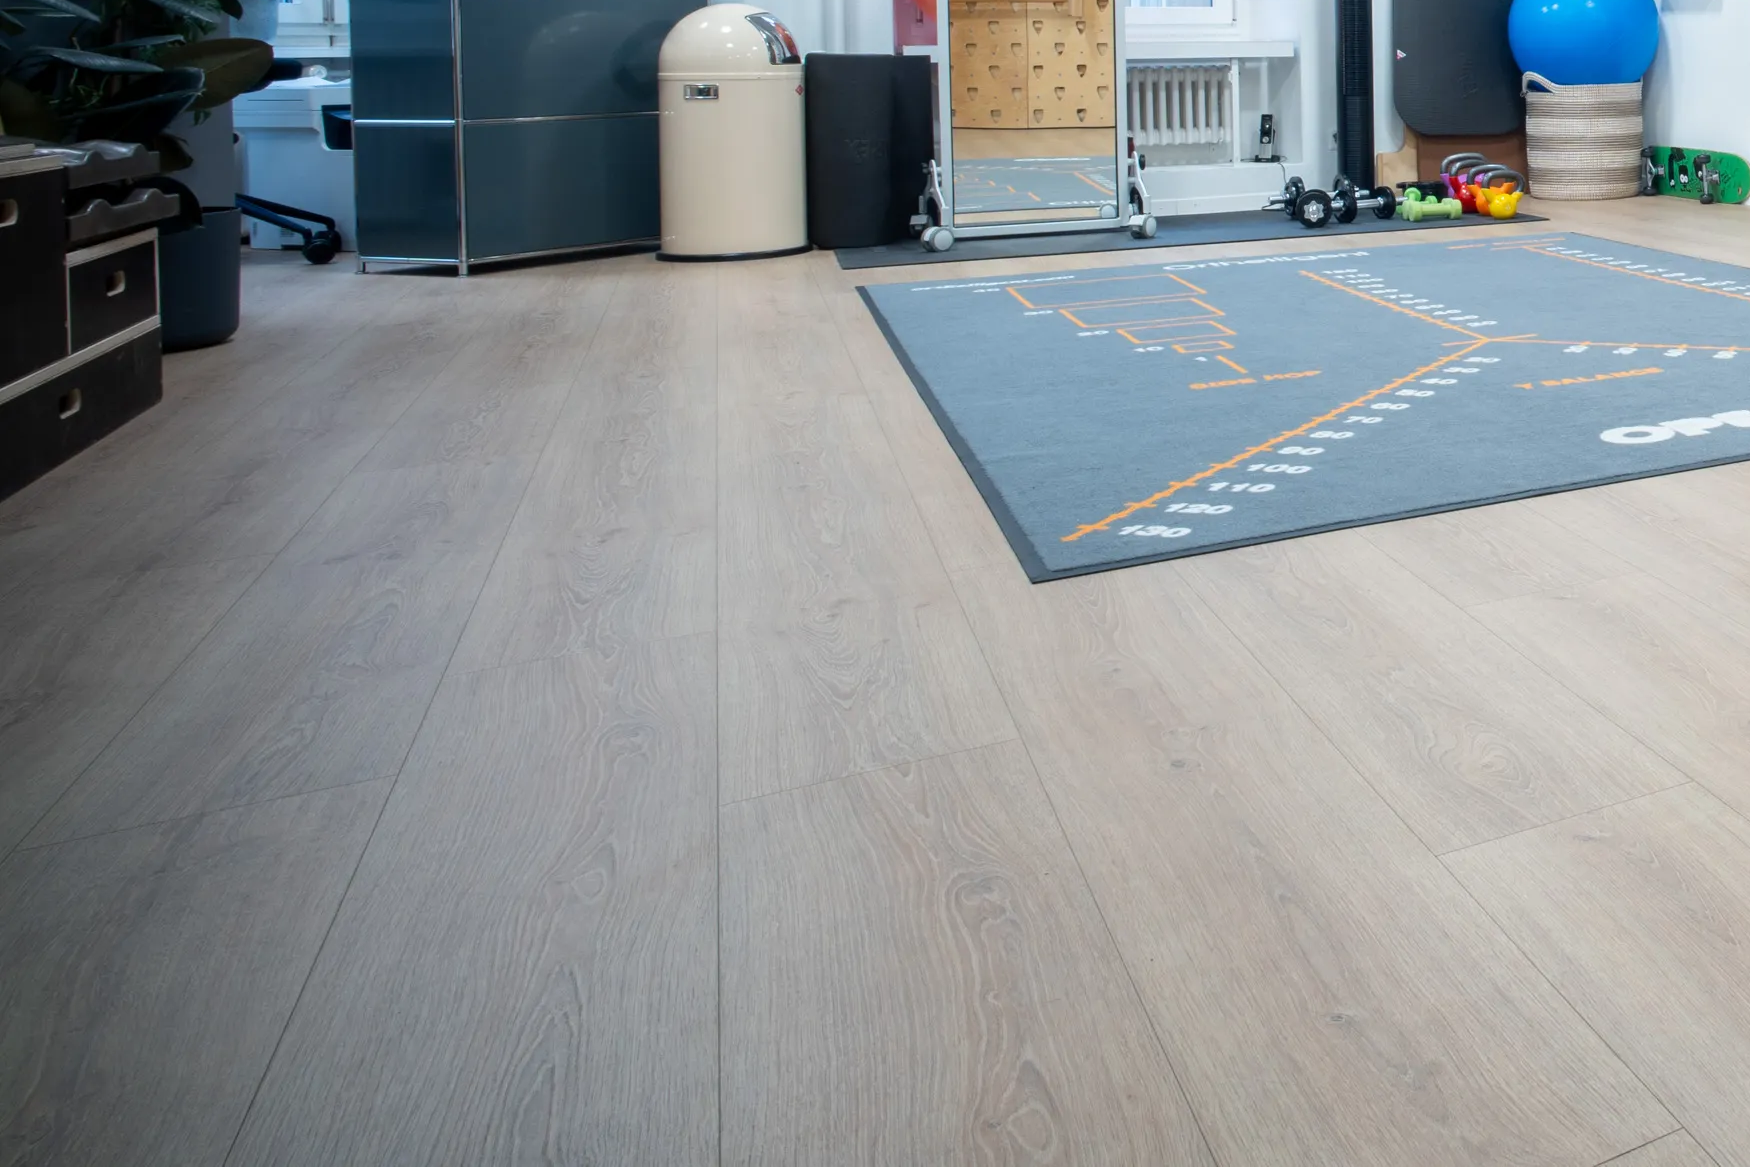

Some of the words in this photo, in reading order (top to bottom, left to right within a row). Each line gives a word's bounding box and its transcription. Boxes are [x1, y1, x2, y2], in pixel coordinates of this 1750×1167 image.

[1343, 415, 1384, 424] 70
[1309, 430, 1355, 440] 80
[1277, 446, 1325, 456] 90
[1247, 463, 1313, 474] 100
[1208, 481, 1276, 493] 110
[1165, 502, 1234, 515] 120
[1118, 524, 1192, 538] 130
